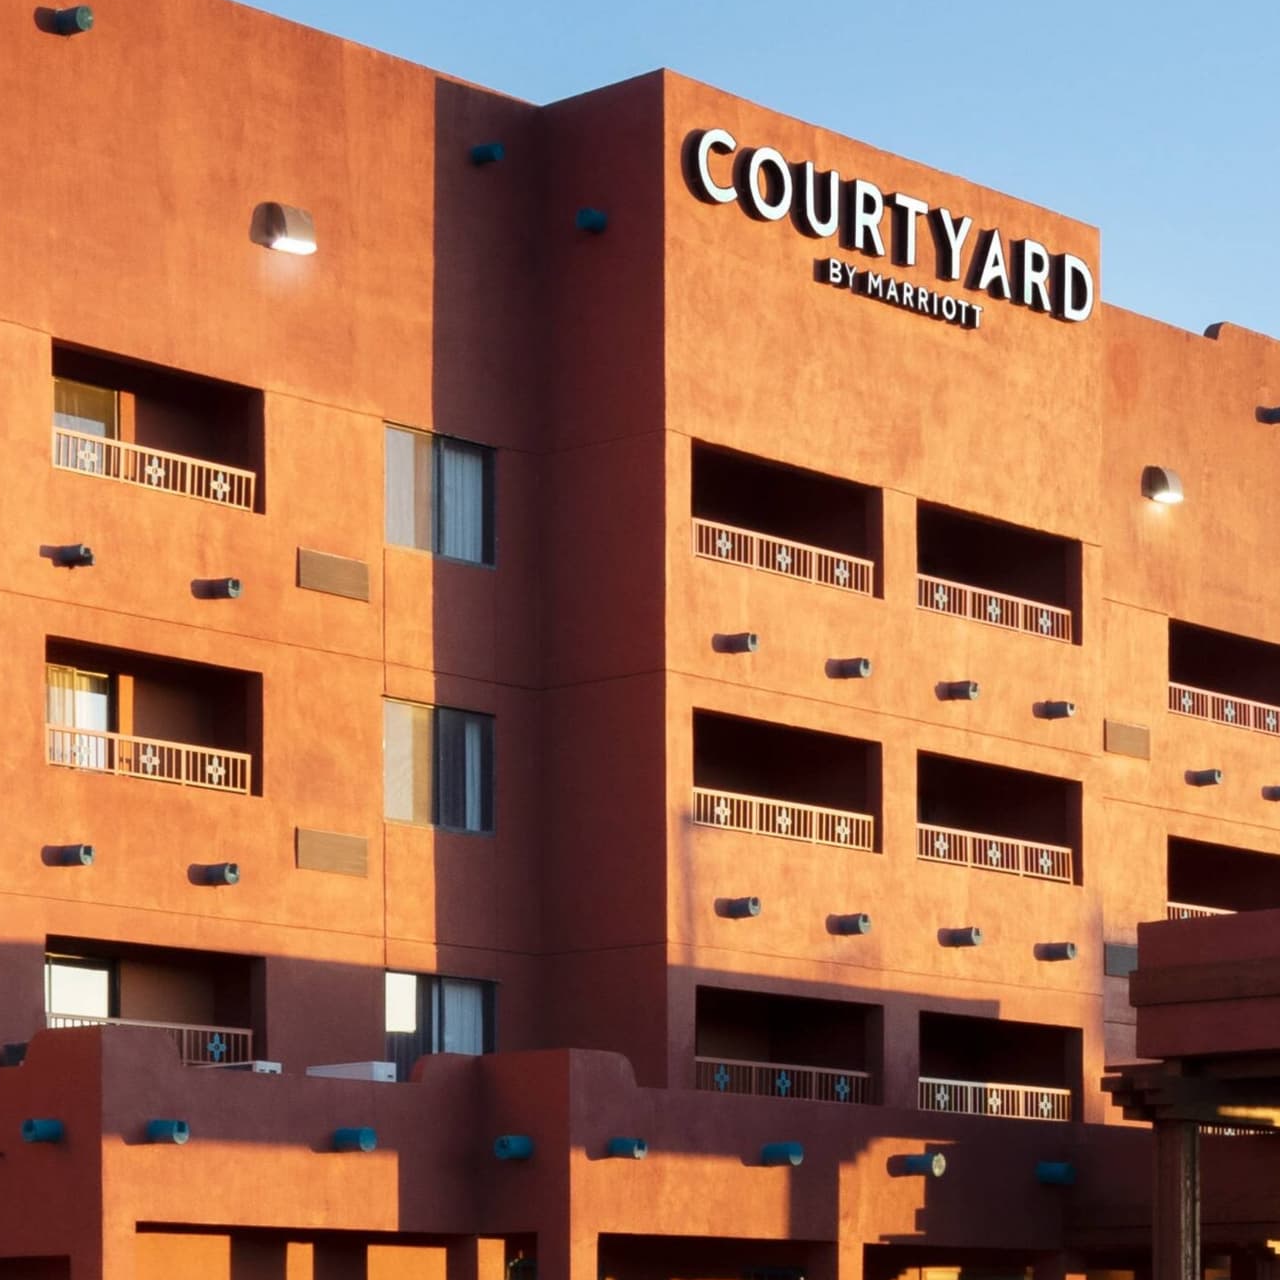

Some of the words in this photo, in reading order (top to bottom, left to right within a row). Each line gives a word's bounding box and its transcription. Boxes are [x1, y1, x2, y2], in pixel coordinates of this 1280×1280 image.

[696, 128, 1095, 323] COURTYARD
[828, 257, 857, 289] BY
[867, 271, 983, 329] MARRIOTT
